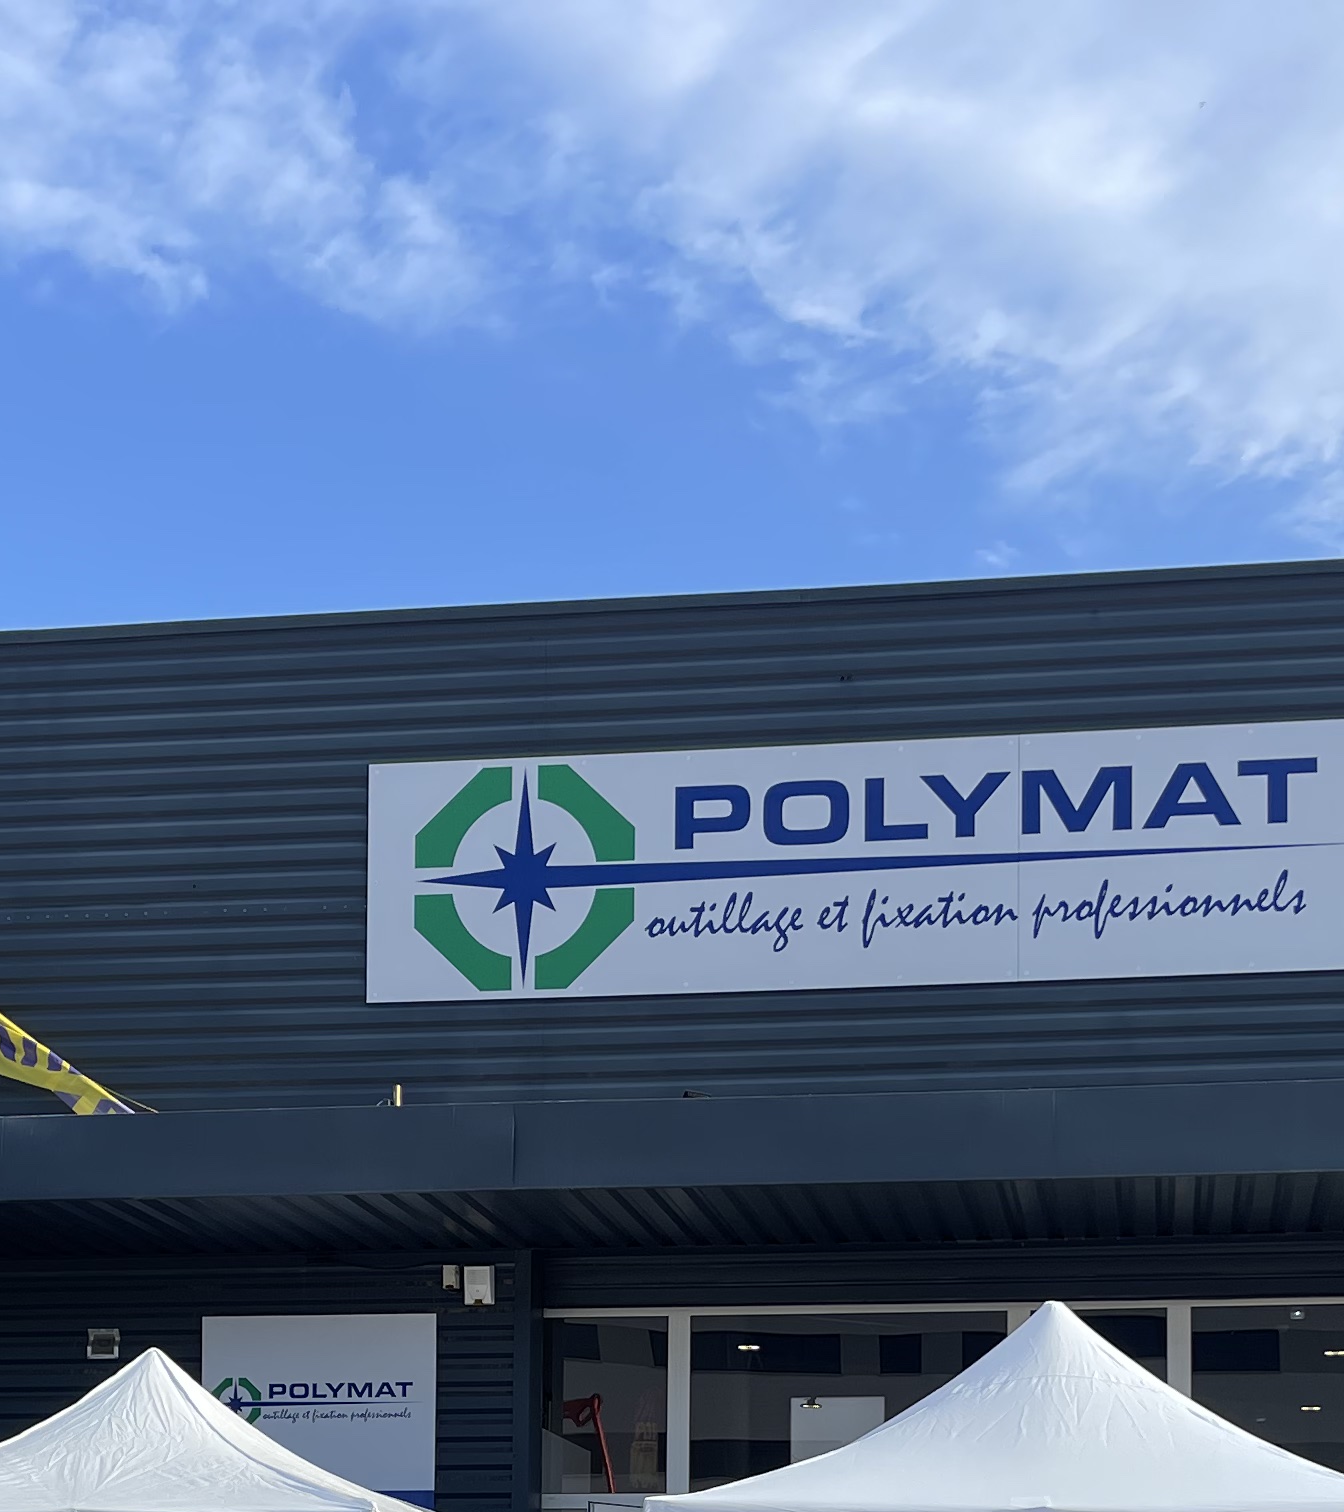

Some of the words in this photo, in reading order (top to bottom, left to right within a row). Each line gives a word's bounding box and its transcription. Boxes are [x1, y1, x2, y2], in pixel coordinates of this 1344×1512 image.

[674, 757, 1318, 850] POLYMAT
[645, 891, 804, 952] outillage
[817, 895, 850, 933] et
[861, 888, 1018, 949] fixation
[1032, 869, 1307, 940] professionnels
[262, 1408, 300, 1423] outillage
[312, 1408, 348, 1423] fixation
[350, 1407, 412, 1423] professionnels
[268, 1381, 415, 1400] POLYMAT
